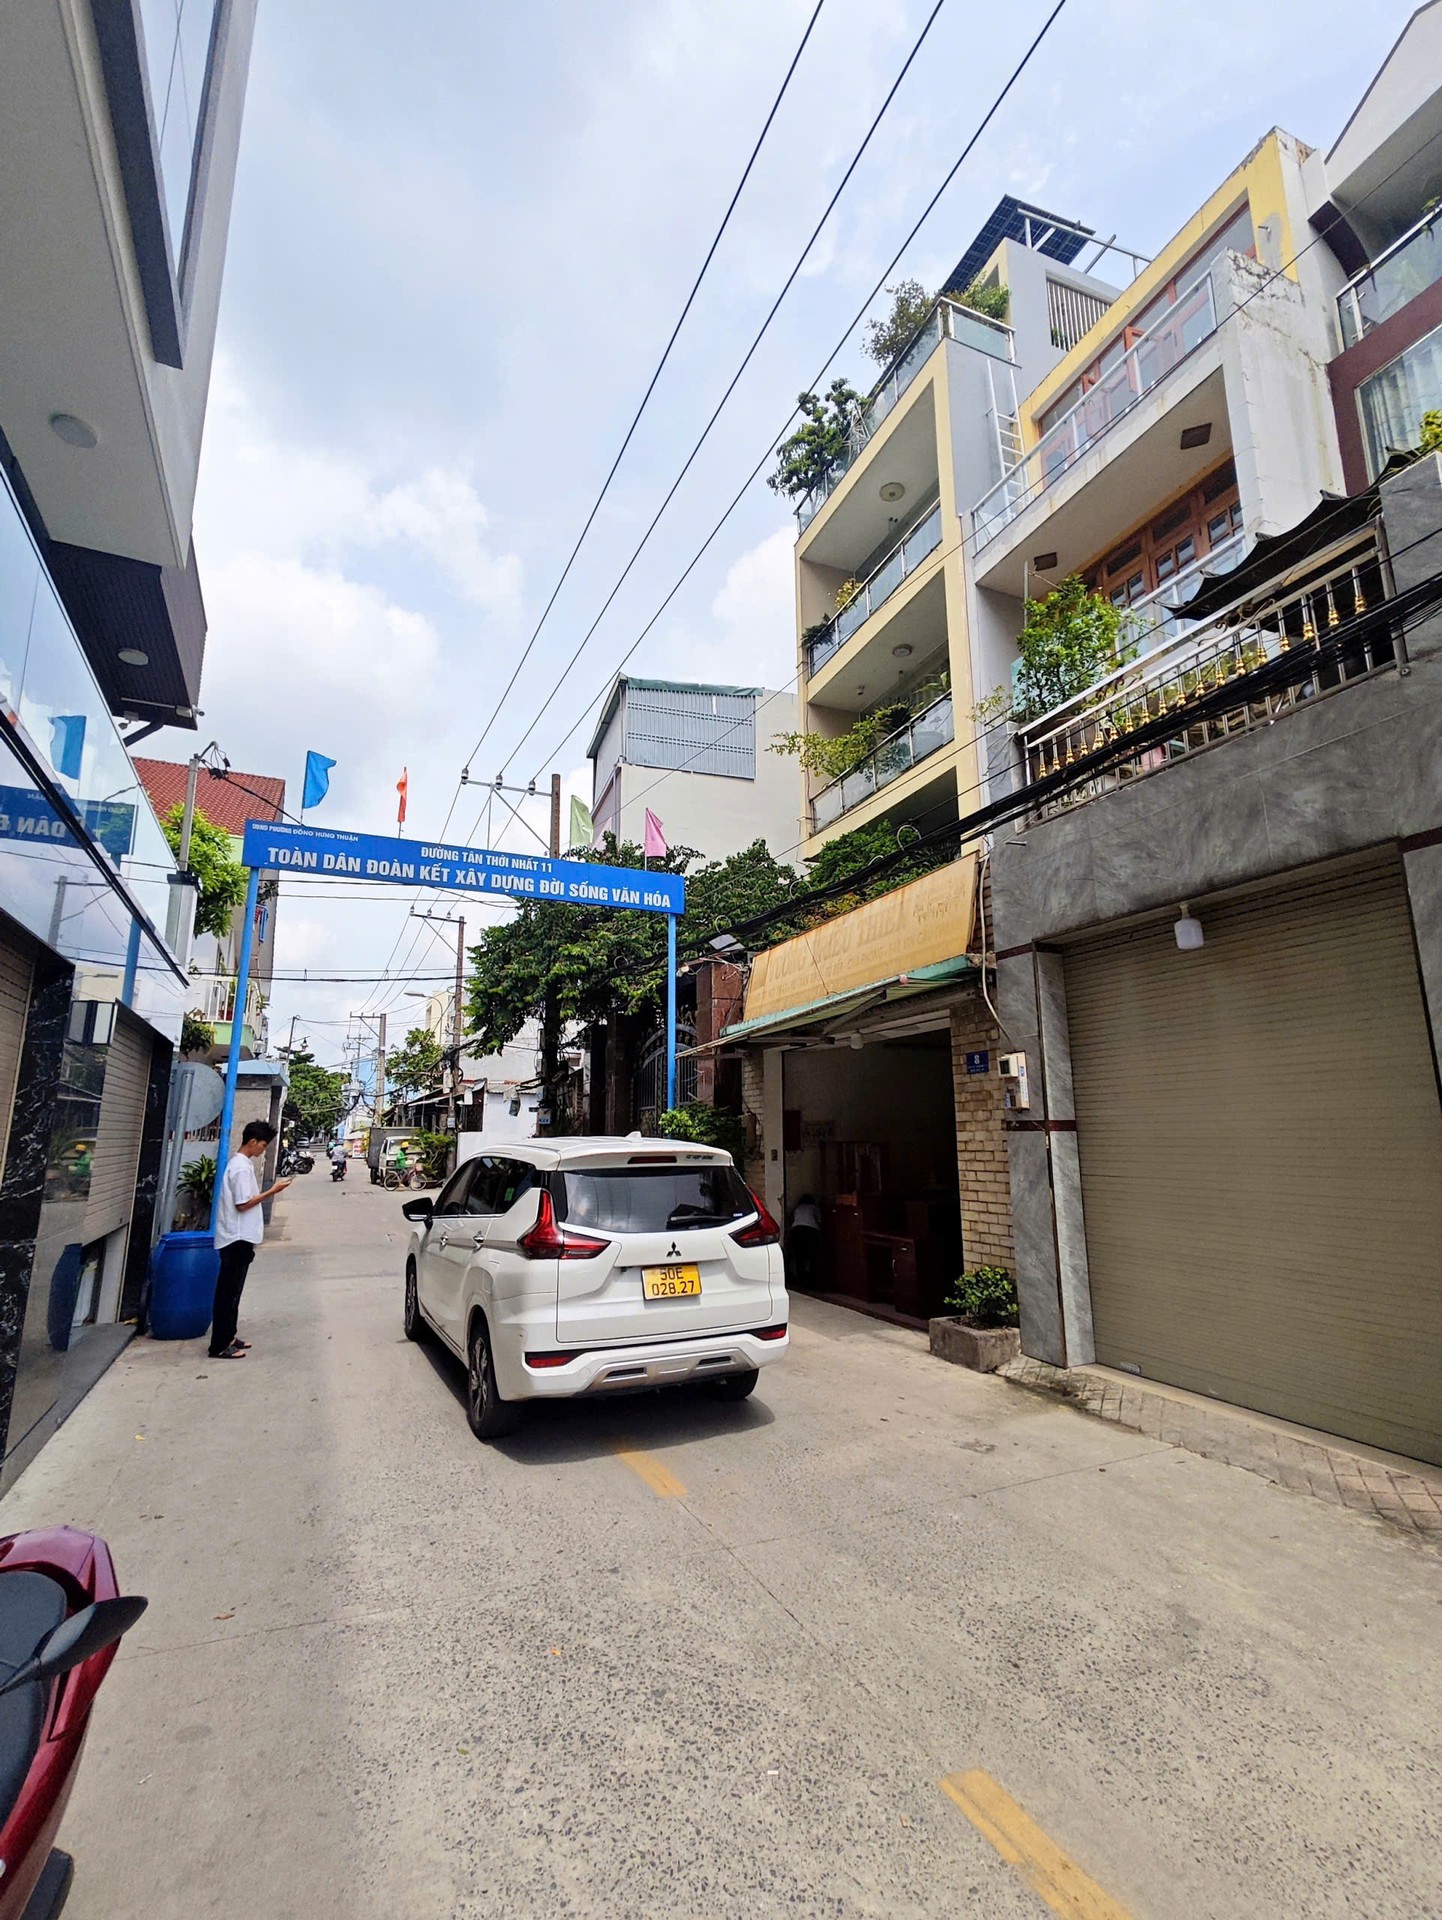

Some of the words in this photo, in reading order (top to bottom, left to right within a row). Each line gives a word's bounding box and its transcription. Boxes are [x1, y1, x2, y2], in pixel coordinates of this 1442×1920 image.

[292, 828, 313, 837] ĐÔNG
[336, 833, 359, 843] THUẬN
[420, 846, 459, 862] ĐƯỜNG
[462, 851, 483, 865] TÂN
[486, 854, 509, 868] THỚI
[511, 856, 539, 872] NHẤT
[542, 863, 552, 873] 11
[267, 846, 316, 867] TOÀN
[323, 852, 361, 873] DÂN
[366, 857, 415, 878] ĐOÀN
[420, 862, 451, 883] KẾT
[455, 869, 486, 887] XÂY
[491, 873, 535, 893] DỰNG
[539, 878, 564, 895] ĐỜI
[569, 879, 608, 900] SỐNG
[612, 887, 640, 904] VĂN
[643, 890, 671, 907] HÓA
[652, 1281, 695, 1296] 028.27
